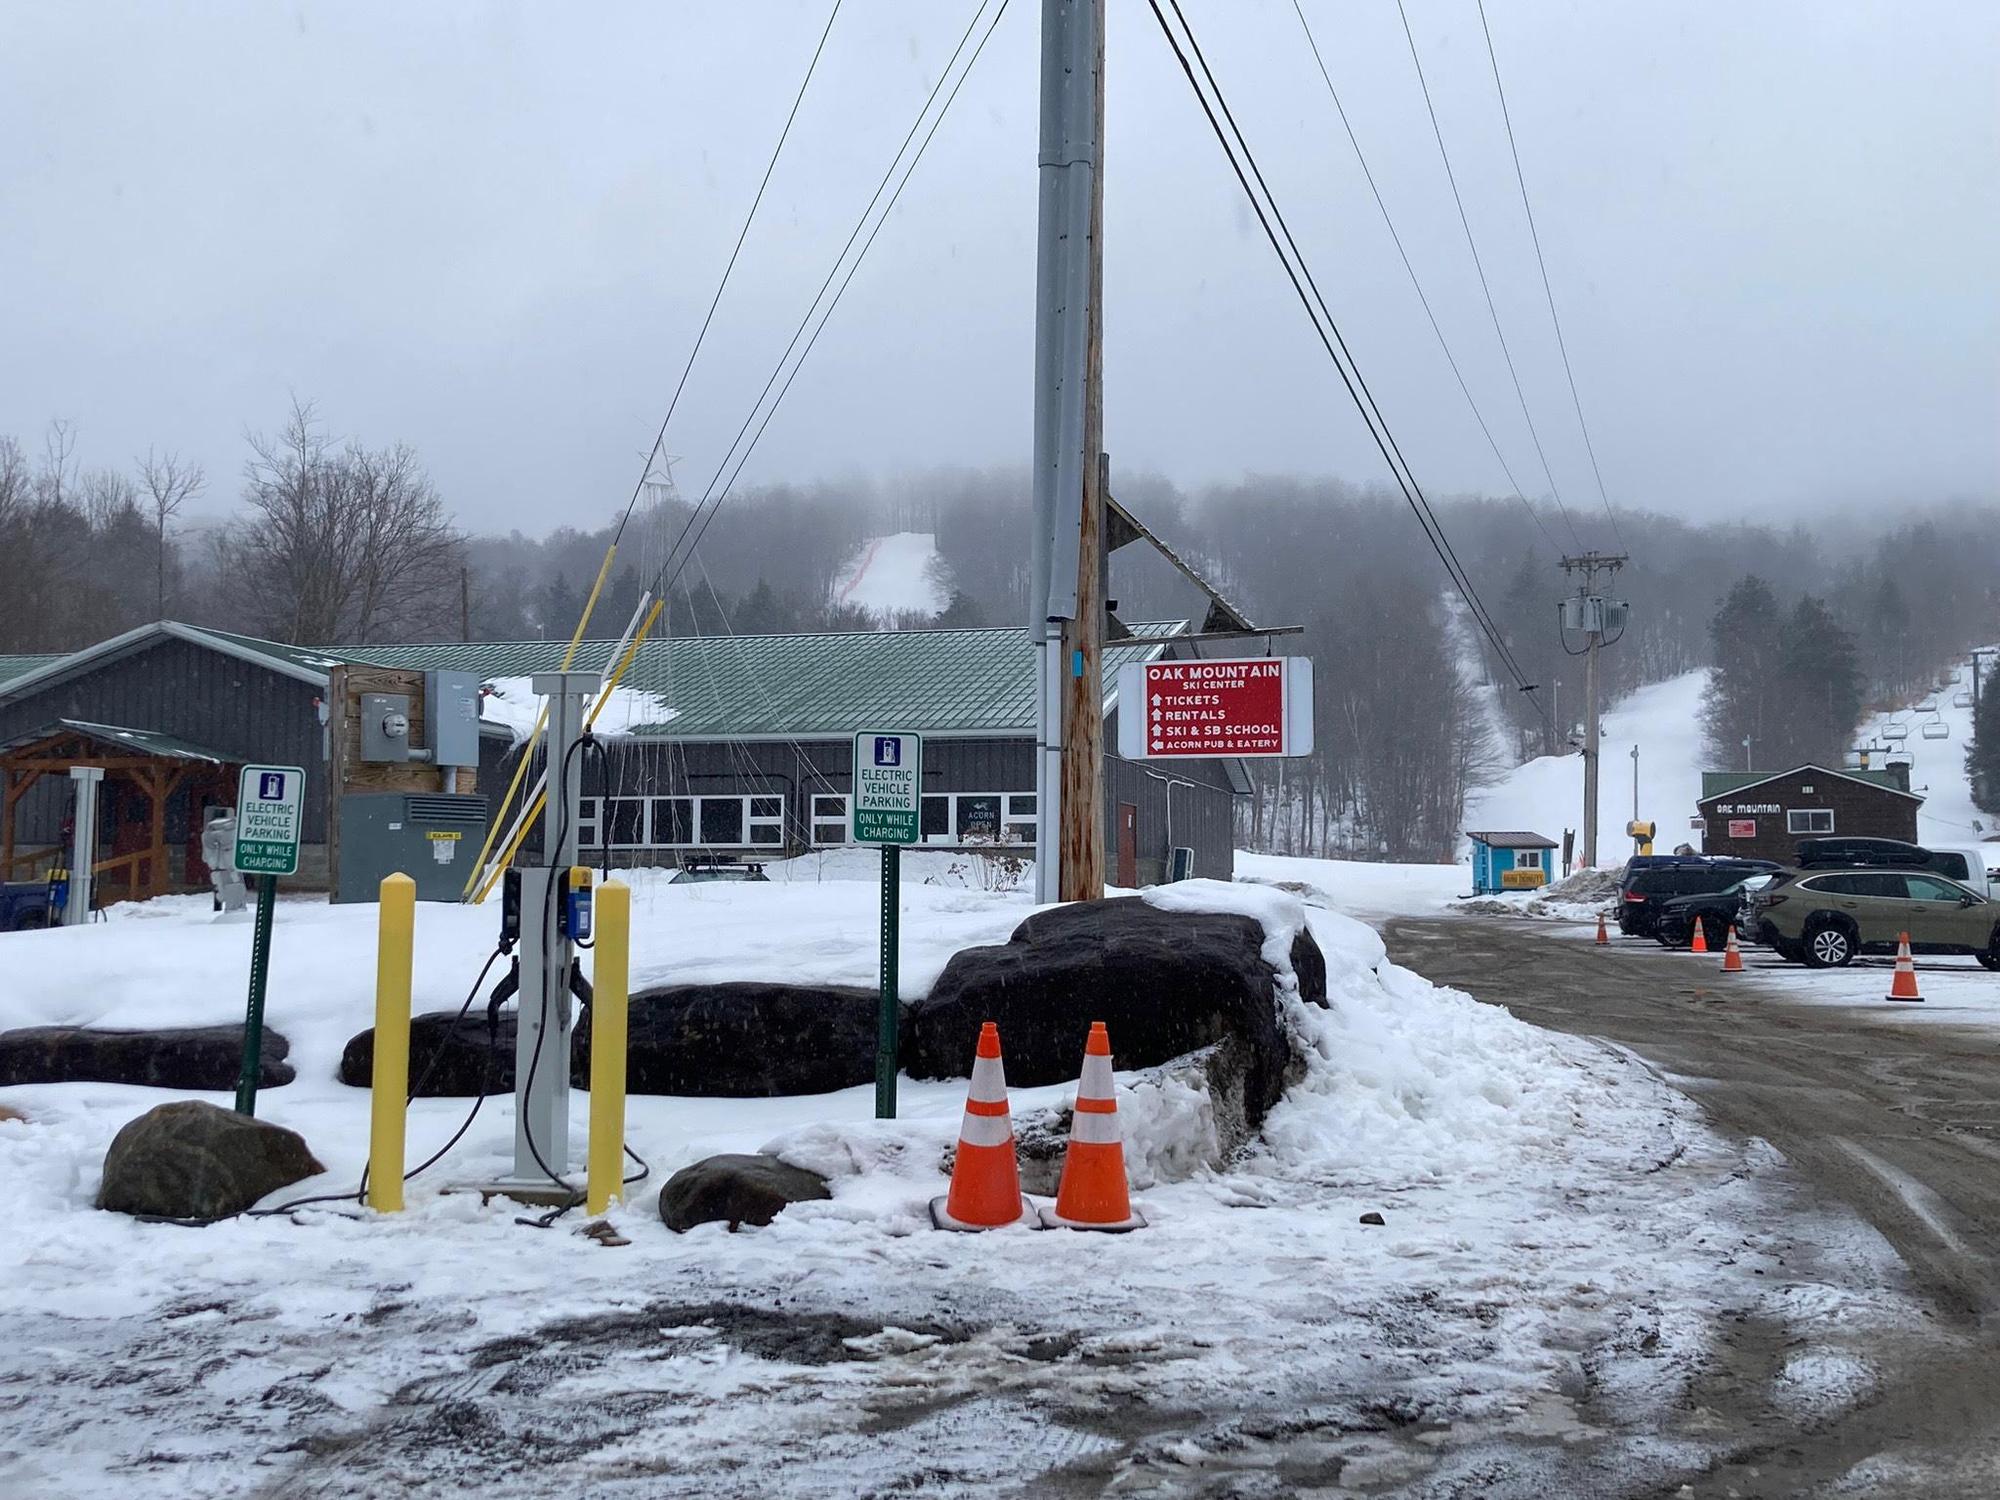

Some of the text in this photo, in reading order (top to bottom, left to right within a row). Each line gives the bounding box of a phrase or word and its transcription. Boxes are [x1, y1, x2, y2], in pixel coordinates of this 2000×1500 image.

[1149, 665, 1280, 681] OAK MOUNTAIN
[1183, 680, 1245, 690] SKI CENTER
[1165, 695, 1220, 705] TICKETS
[1165, 710, 1226, 721] RENTALS
[1166, 724, 1279, 736] SKI & SB SCHOOL
[1167, 739, 1279, 749] ACORN PUB & EATERY
[862, 769, 913, 782] ELECTRIC
[864, 782, 910, 795] VEHICLE
[863, 796, 911, 808] PARKING
[246, 802, 294, 815] ELECTRIC
[1737, 804, 1781, 814] MOUNTAIN
[247, 815, 291, 827] VEHICLE
[859, 813, 914, 826] ONLY WHILE
[968, 811, 995, 819] ACORN
[245, 827, 290, 840] PARKING
[863, 827, 909, 839] CHARGING
[240, 843, 293, 857] ONLY WHILE
[243, 857, 287, 869] CHARGING
